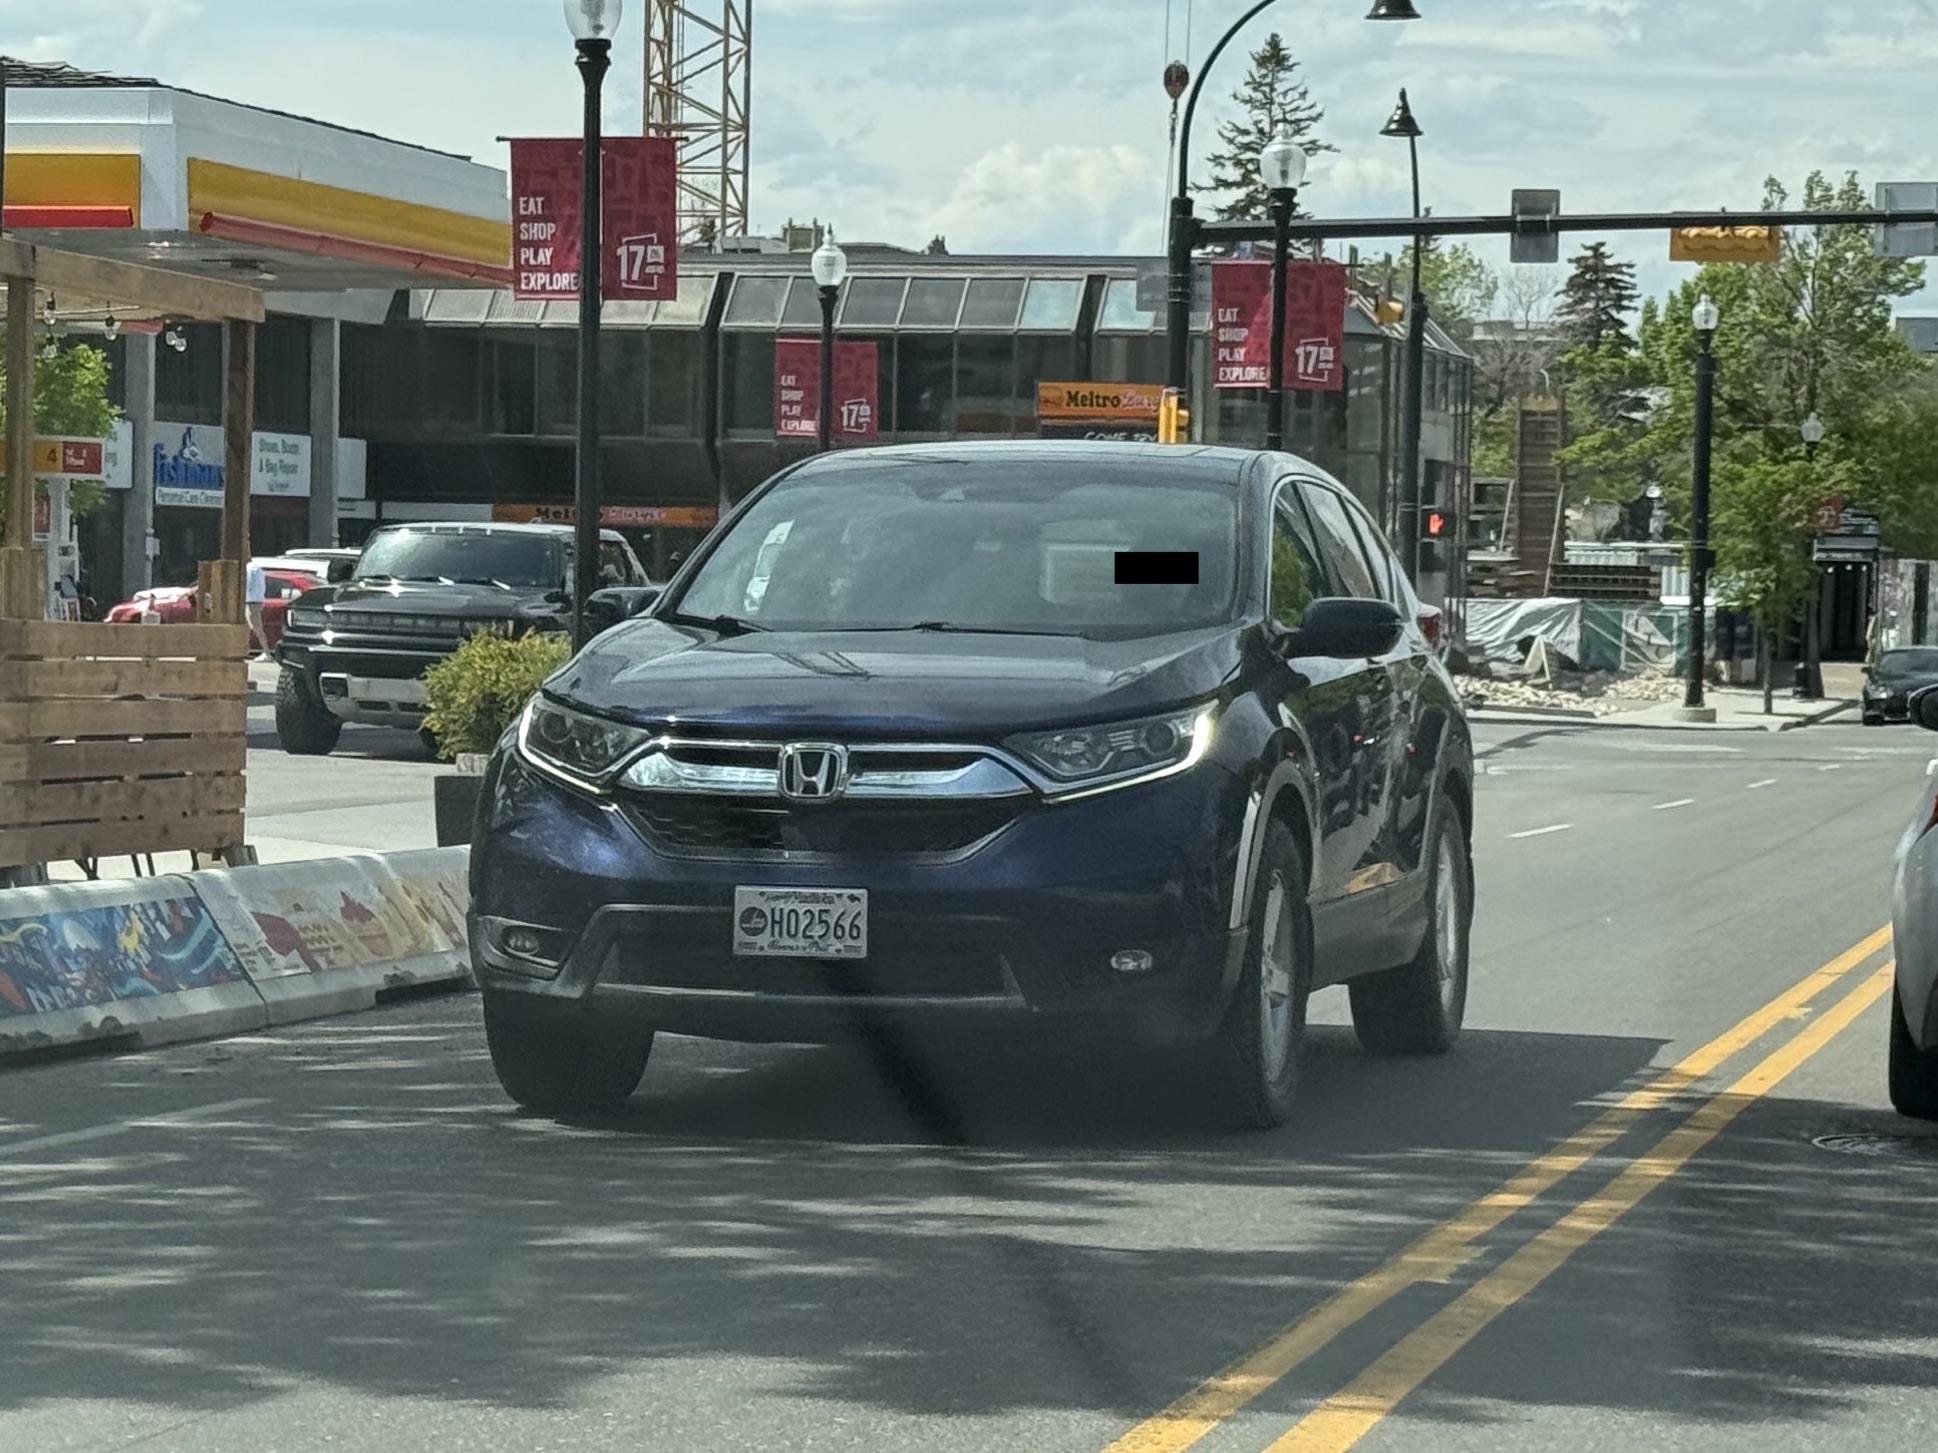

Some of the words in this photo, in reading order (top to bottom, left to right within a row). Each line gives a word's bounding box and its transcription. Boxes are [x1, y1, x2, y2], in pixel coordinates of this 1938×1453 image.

[519, 197, 544, 215] EAT
[520, 222, 556, 241] SHOP
[520, 247, 554, 266] PLAY
[616, 244, 645, 281] 17
[520, 272, 579, 291] EXPLORE
[1218, 308, 1239, 322] EAT
[1218, 328, 1248, 342] SHOP
[1218, 347, 1246, 362] PLAY
[1295, 345, 1318, 374] 17
[1219, 366, 1266, 381] EXPLORE
